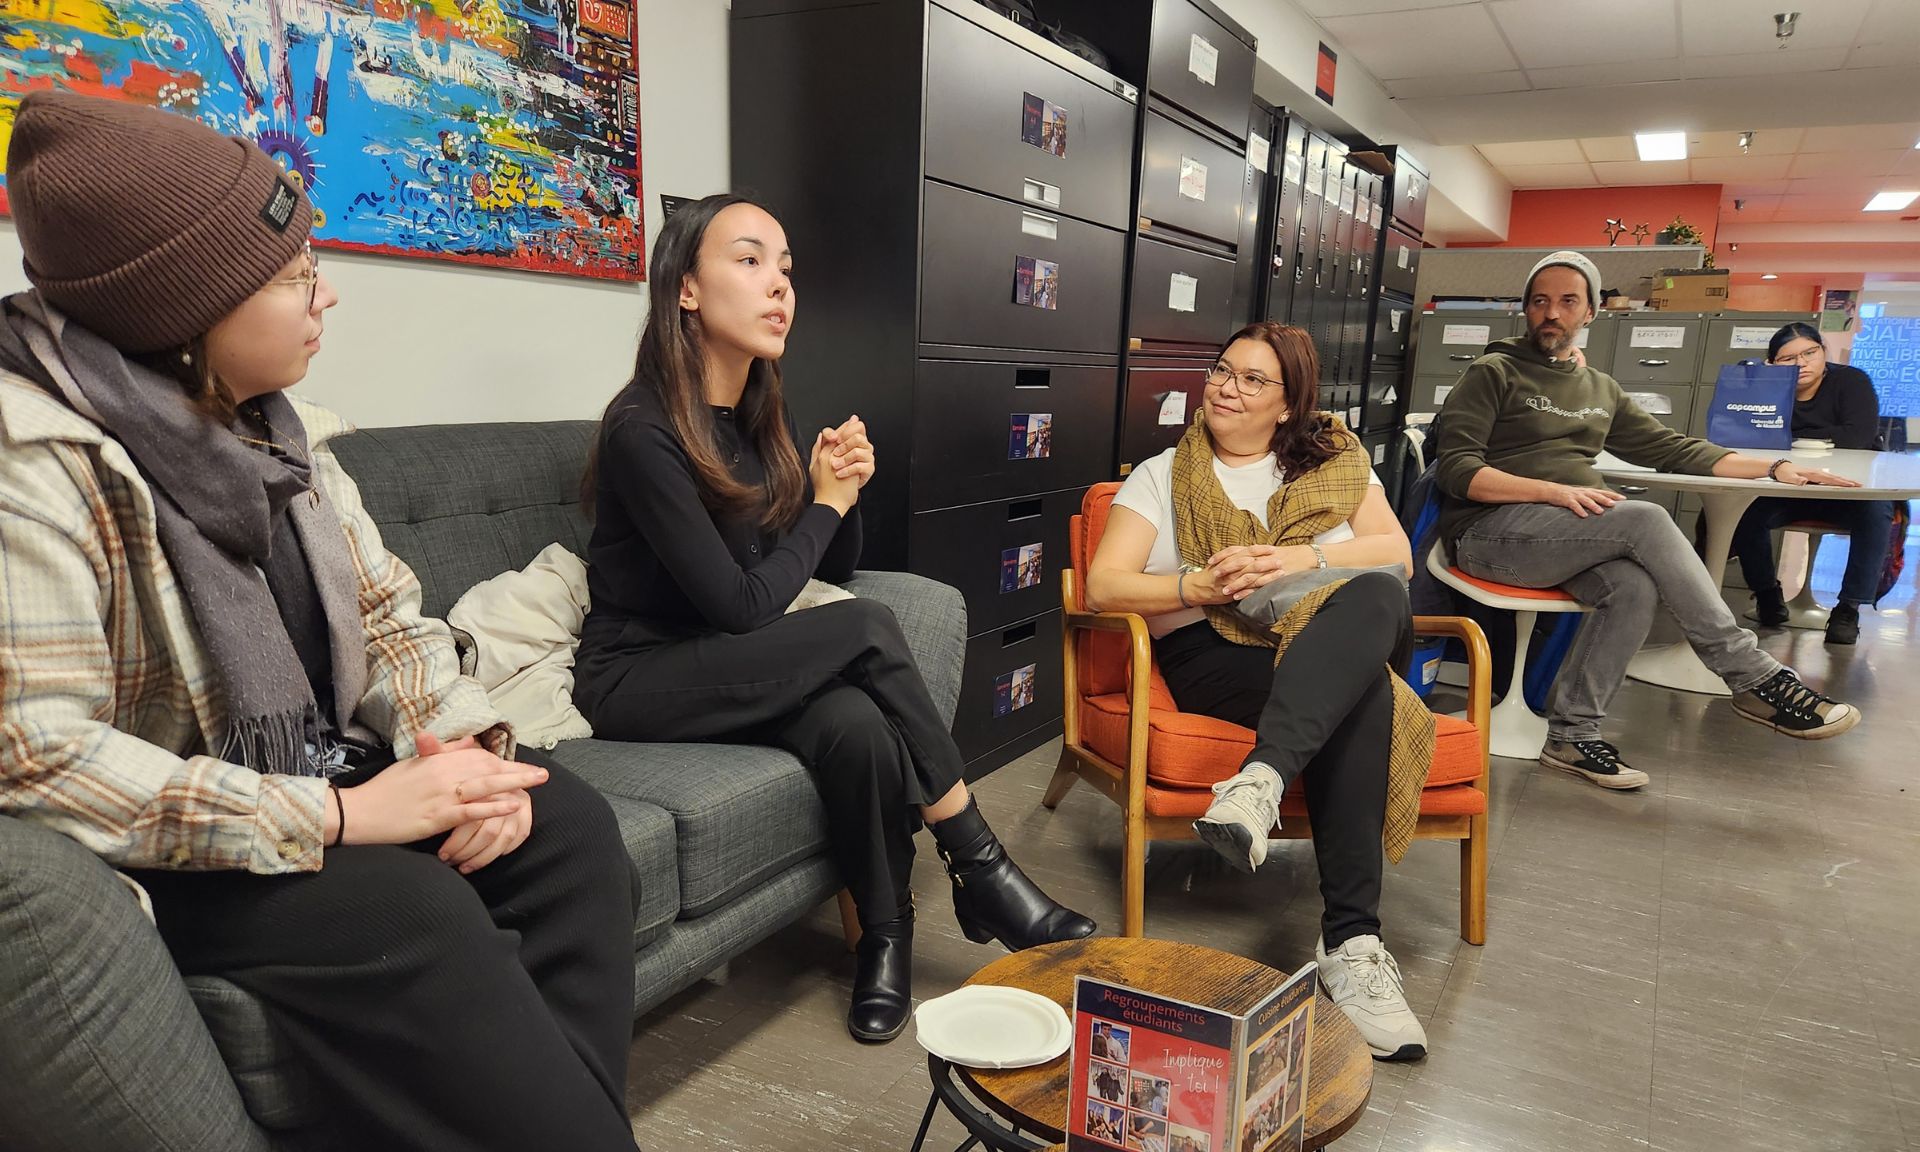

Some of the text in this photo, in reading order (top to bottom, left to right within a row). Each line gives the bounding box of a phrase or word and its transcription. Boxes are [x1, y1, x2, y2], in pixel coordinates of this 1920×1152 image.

[1103, 988, 1206, 1026] Regroupements
[1122, 1007, 1184, 1033] étudiants
[1258, 1002, 1281, 1026] Cuisine
[1162, 1046, 1225, 1077] Implique
[1186, 1072, 1209, 1094] toi
